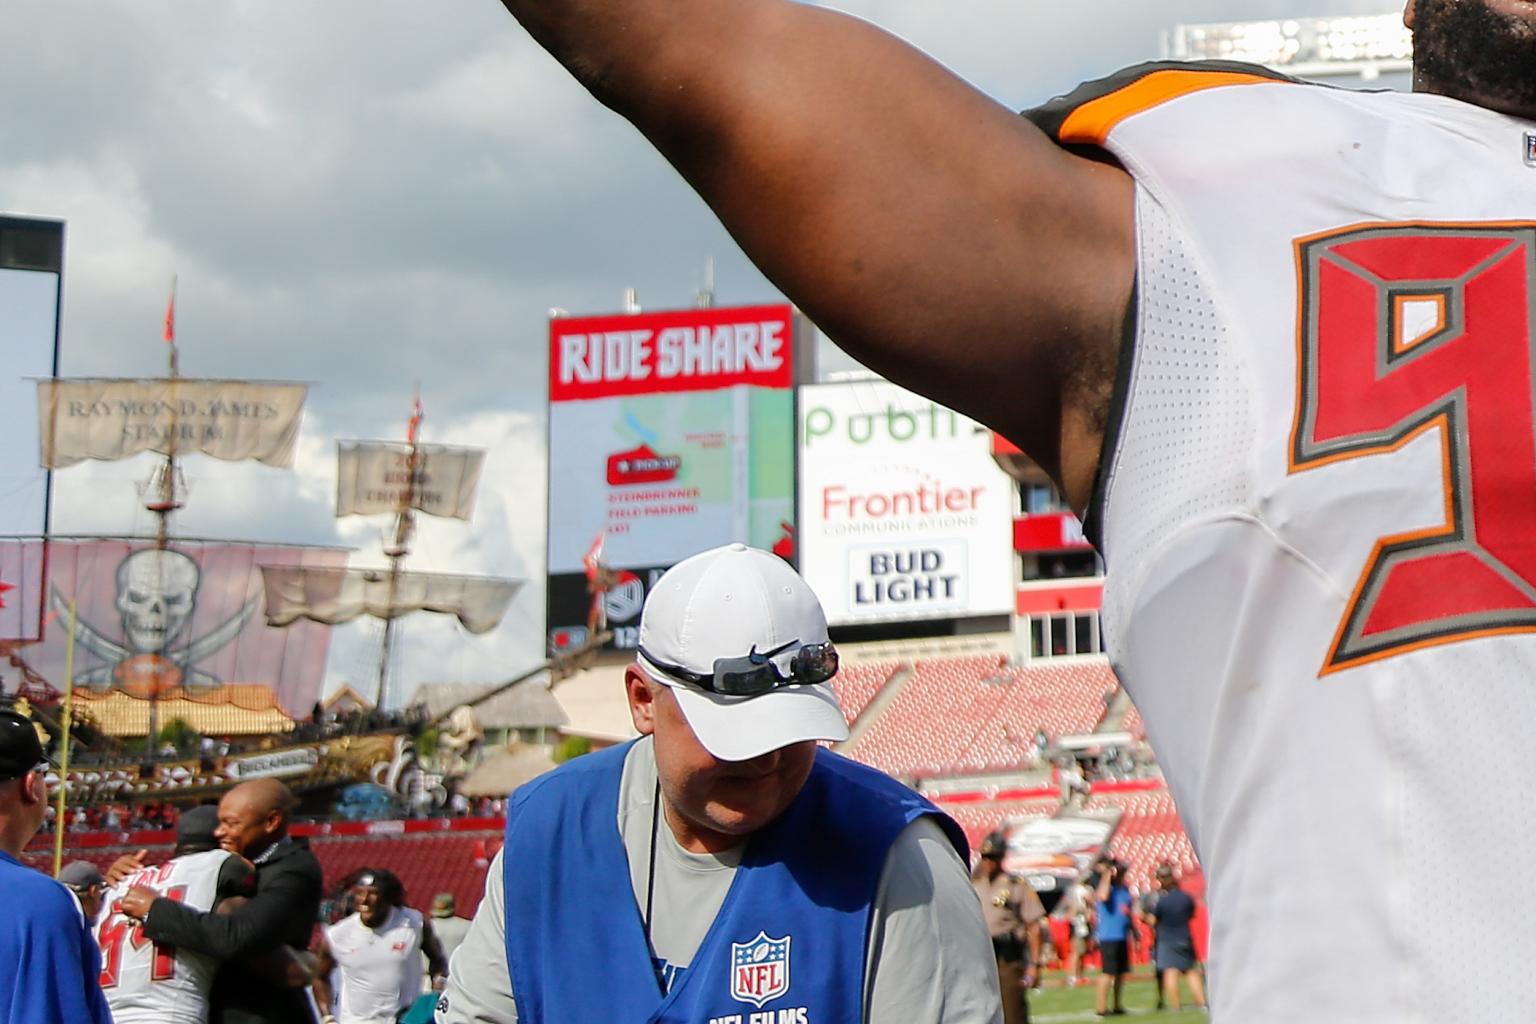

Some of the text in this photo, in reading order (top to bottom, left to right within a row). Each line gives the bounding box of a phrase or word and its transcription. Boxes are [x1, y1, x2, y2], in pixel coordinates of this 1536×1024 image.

[560, 320, 786, 385] RIDE SHARE
[69, 397, 280, 419] RAYMOND JAMES
[805, 401, 957, 447] Publi
[822, 479, 986, 520] Frontier
[823, 514, 980, 536] COMMUNICATIONS
[870, 549, 942, 577] BUD
[855, 575, 960, 606] LIGHT
[738, 963, 782, 996] NFL
